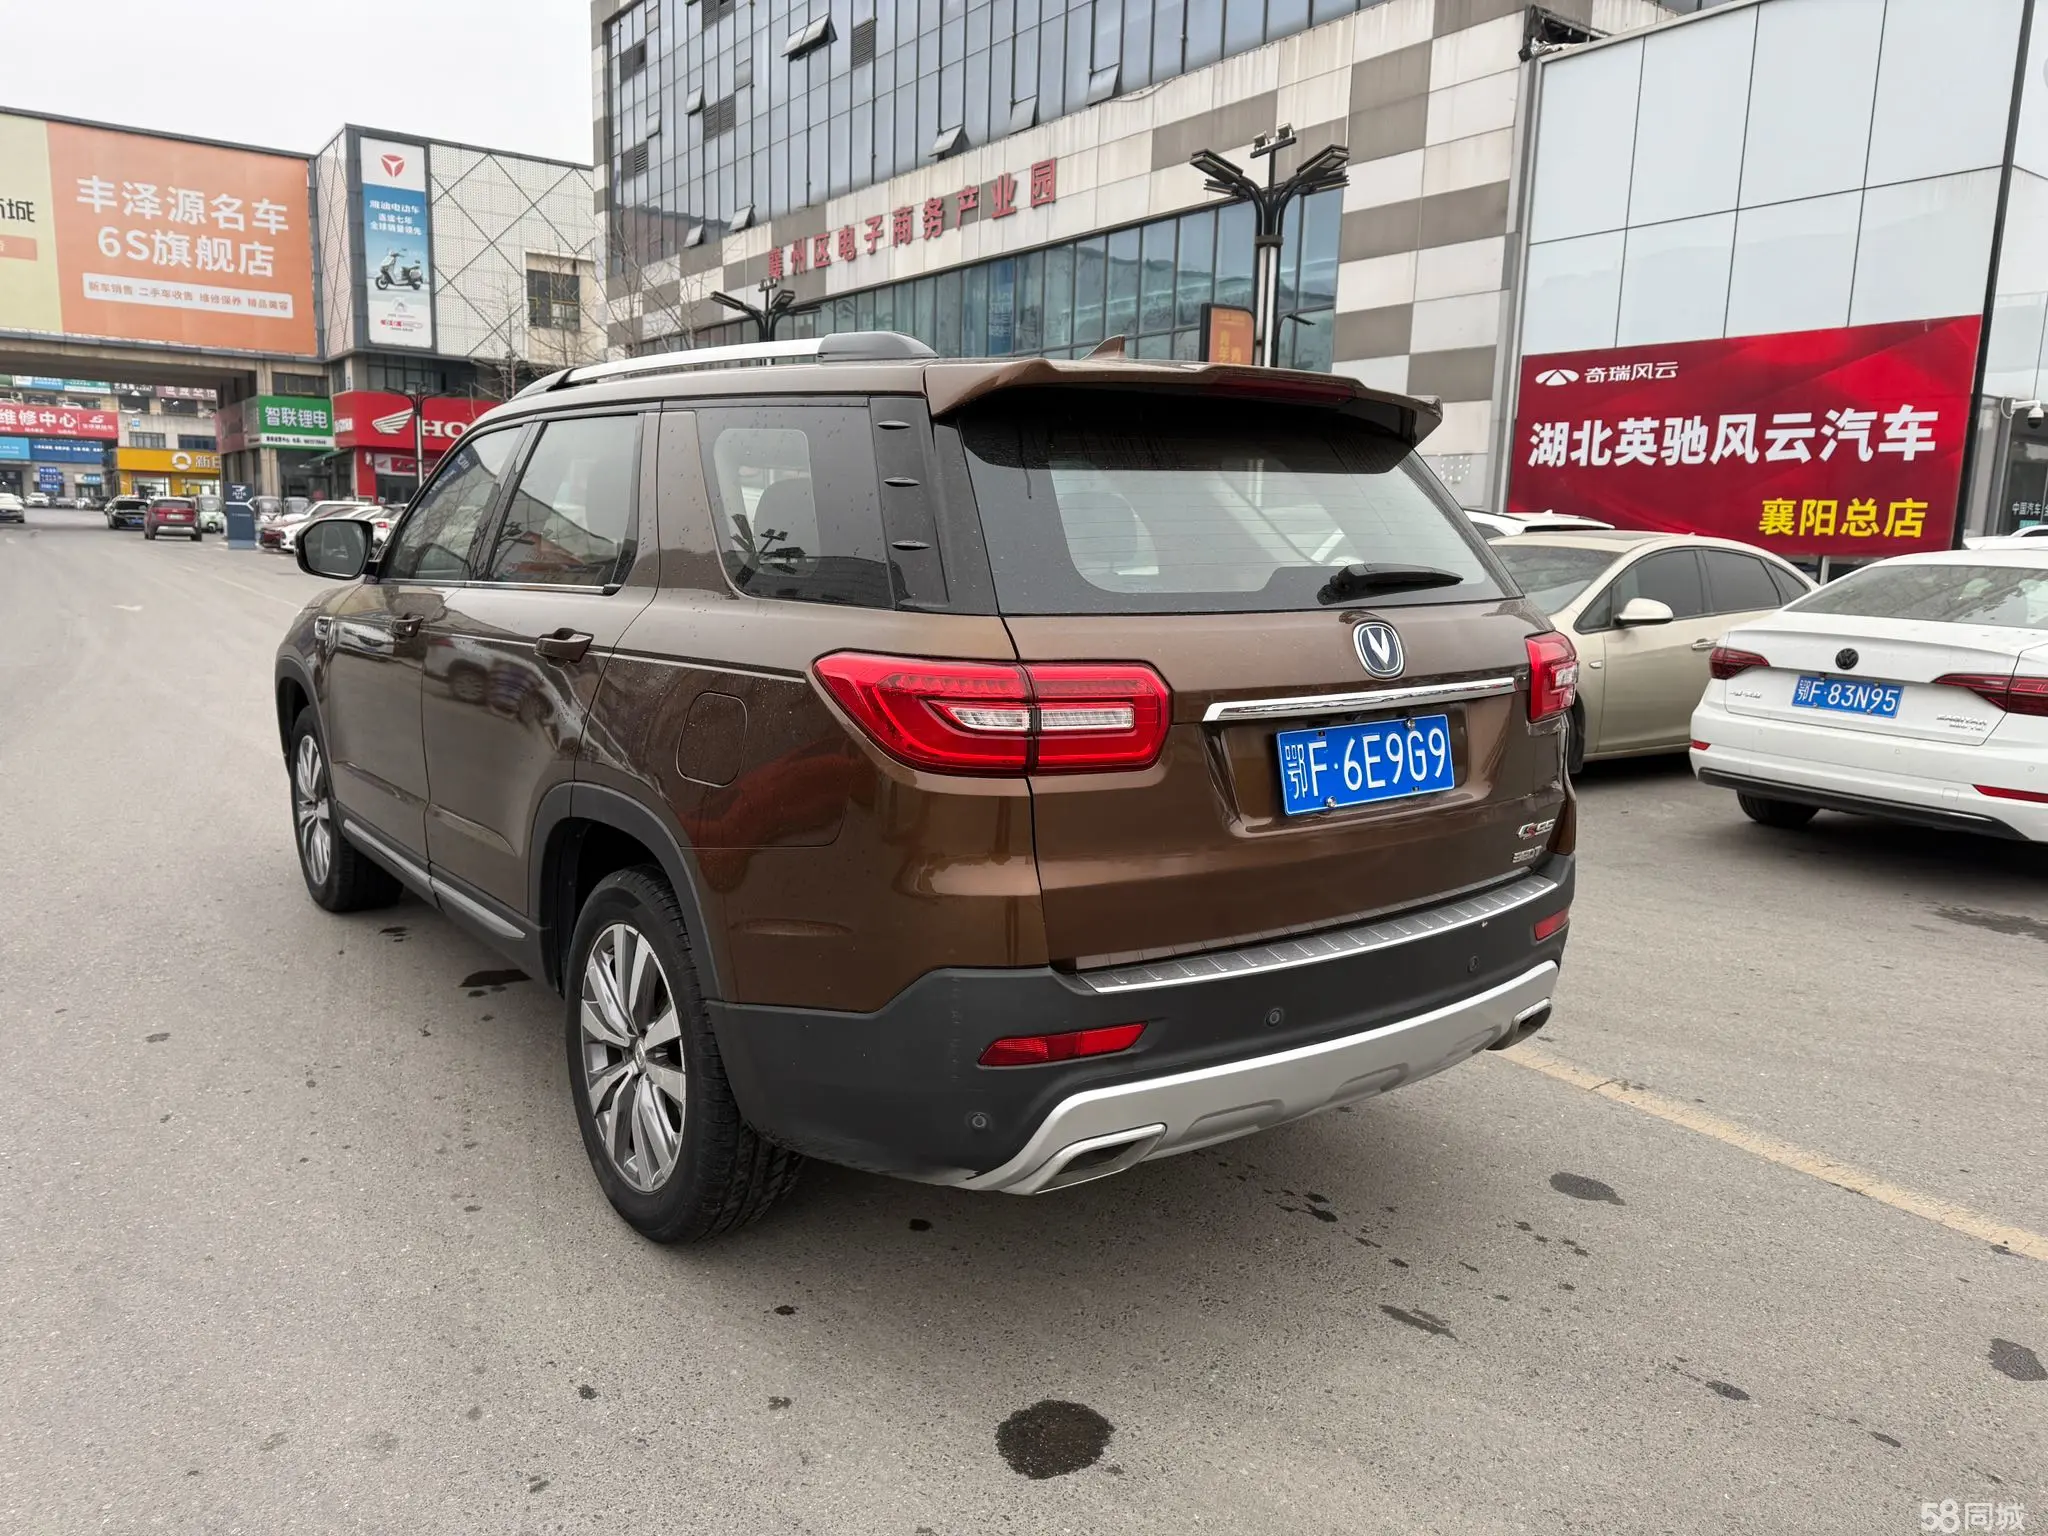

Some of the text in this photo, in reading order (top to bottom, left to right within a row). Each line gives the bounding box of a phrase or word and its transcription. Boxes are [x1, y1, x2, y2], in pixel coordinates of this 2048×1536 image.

[76, 174, 289, 236] 丰泽源名车
[768, 157, 1057, 280] 襄州区电子商务产业园
[97, 225, 275, 277] 6S旗舰店
[88, 280, 133, 295] 新车销售
[1584, 361, 1679, 384] 奇瑞风云
[264, 405, 329, 429] 智联锂电
[1527, 405, 1939, 468] 湖北英驰风云汽车
[1758, 497, 1929, 538] 襄阳总店
